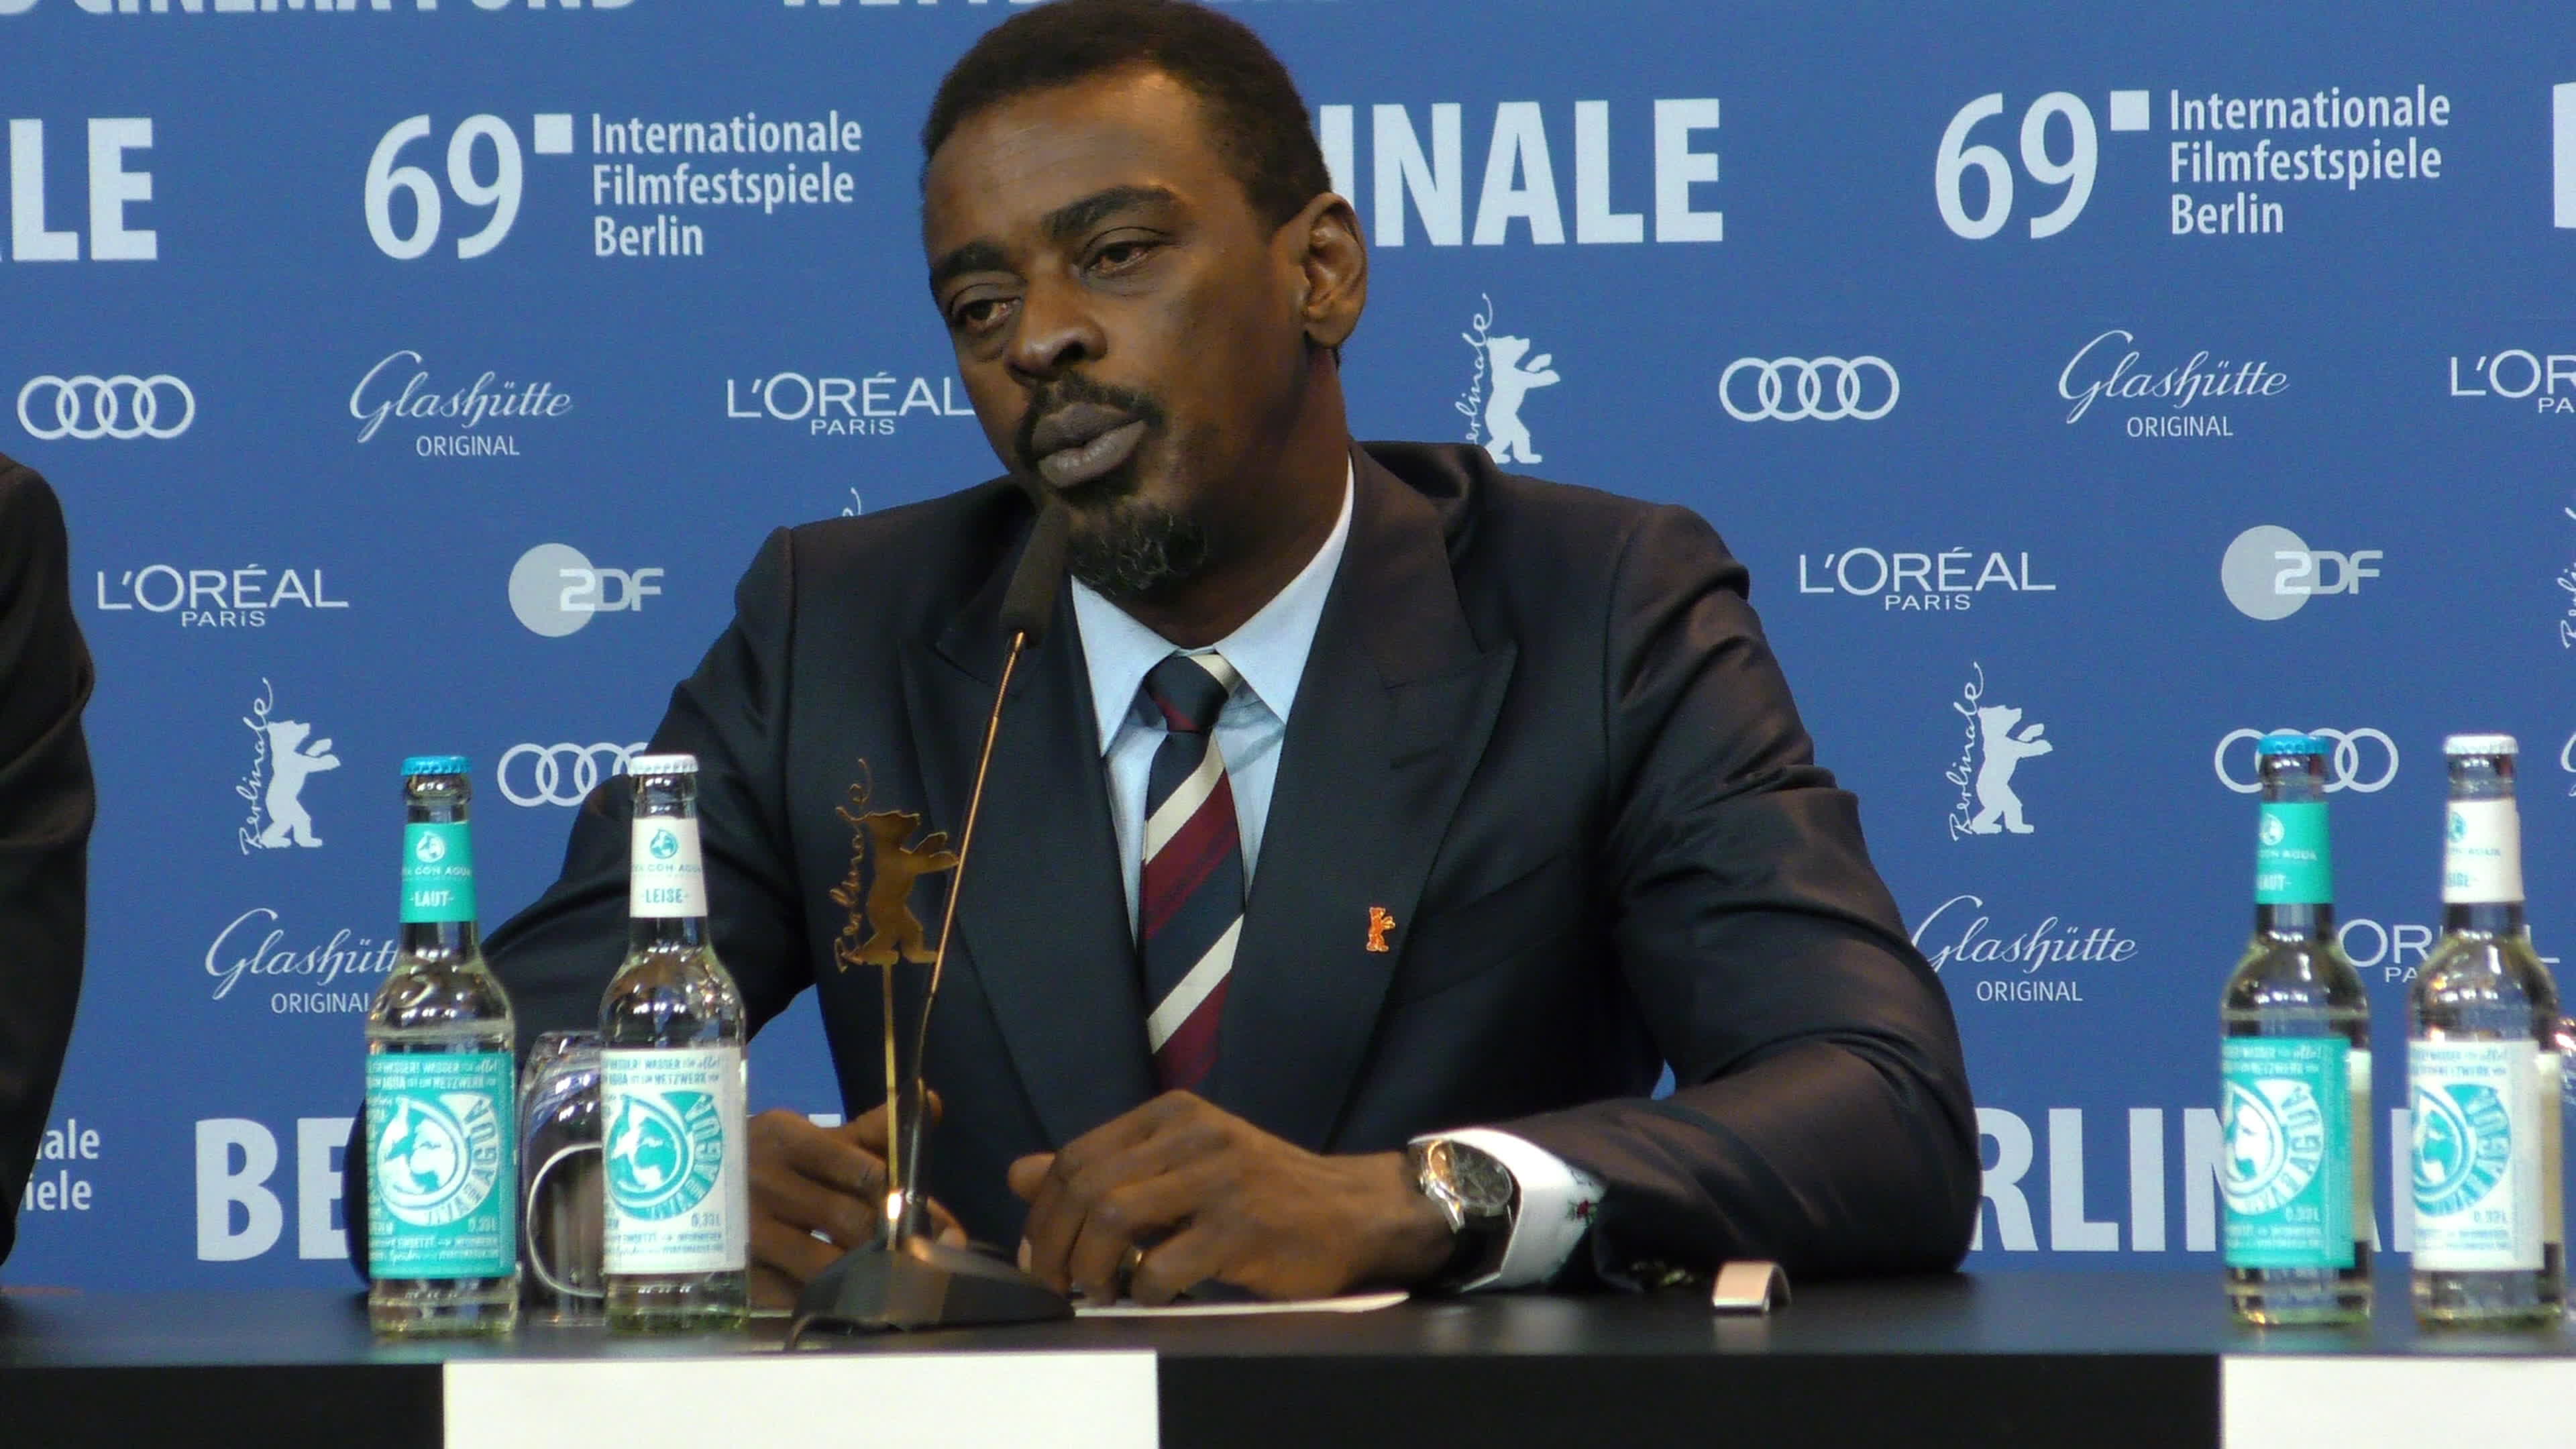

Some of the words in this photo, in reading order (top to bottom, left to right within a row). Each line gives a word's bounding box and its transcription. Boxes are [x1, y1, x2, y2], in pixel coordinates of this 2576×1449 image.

[2171, 84, 2451, 131] Internationale
[592, 111, 863, 154] Internationale
[364, 114, 523, 260] 69
[594, 162, 855, 214] Filmfestspiele
[1935, 91, 2098, 240] 69
[2171, 137, 2443, 191] Filmfestspiele
[594, 215, 704, 257] Berlin
[2171, 192, 2284, 235] Berlin
[1454, 291, 1493, 445] erlinale
[2058, 329, 2290, 425] Glashütte
[350, 350, 574, 443] Glashütte
[415, 435, 520, 457] ORIGINAL
[2126, 415, 2234, 438] ORIGINAL
[97, 564, 349, 612] L'ORÉAL
[559, 568, 664, 612] ZDF
[1799, 547, 2057, 596] L'ORÉAL
[2273, 549, 2383, 595] ZDF
[235, 677, 273, 856] Berlinale
[1945, 661, 1984, 841] Berlinale
[205, 908, 399, 1000] Glashütt
[1911, 894, 2139, 974] Glashütte
[1976, 980, 2084, 1002] ORIGINAL
[36, 1118, 100, 1160] ale
